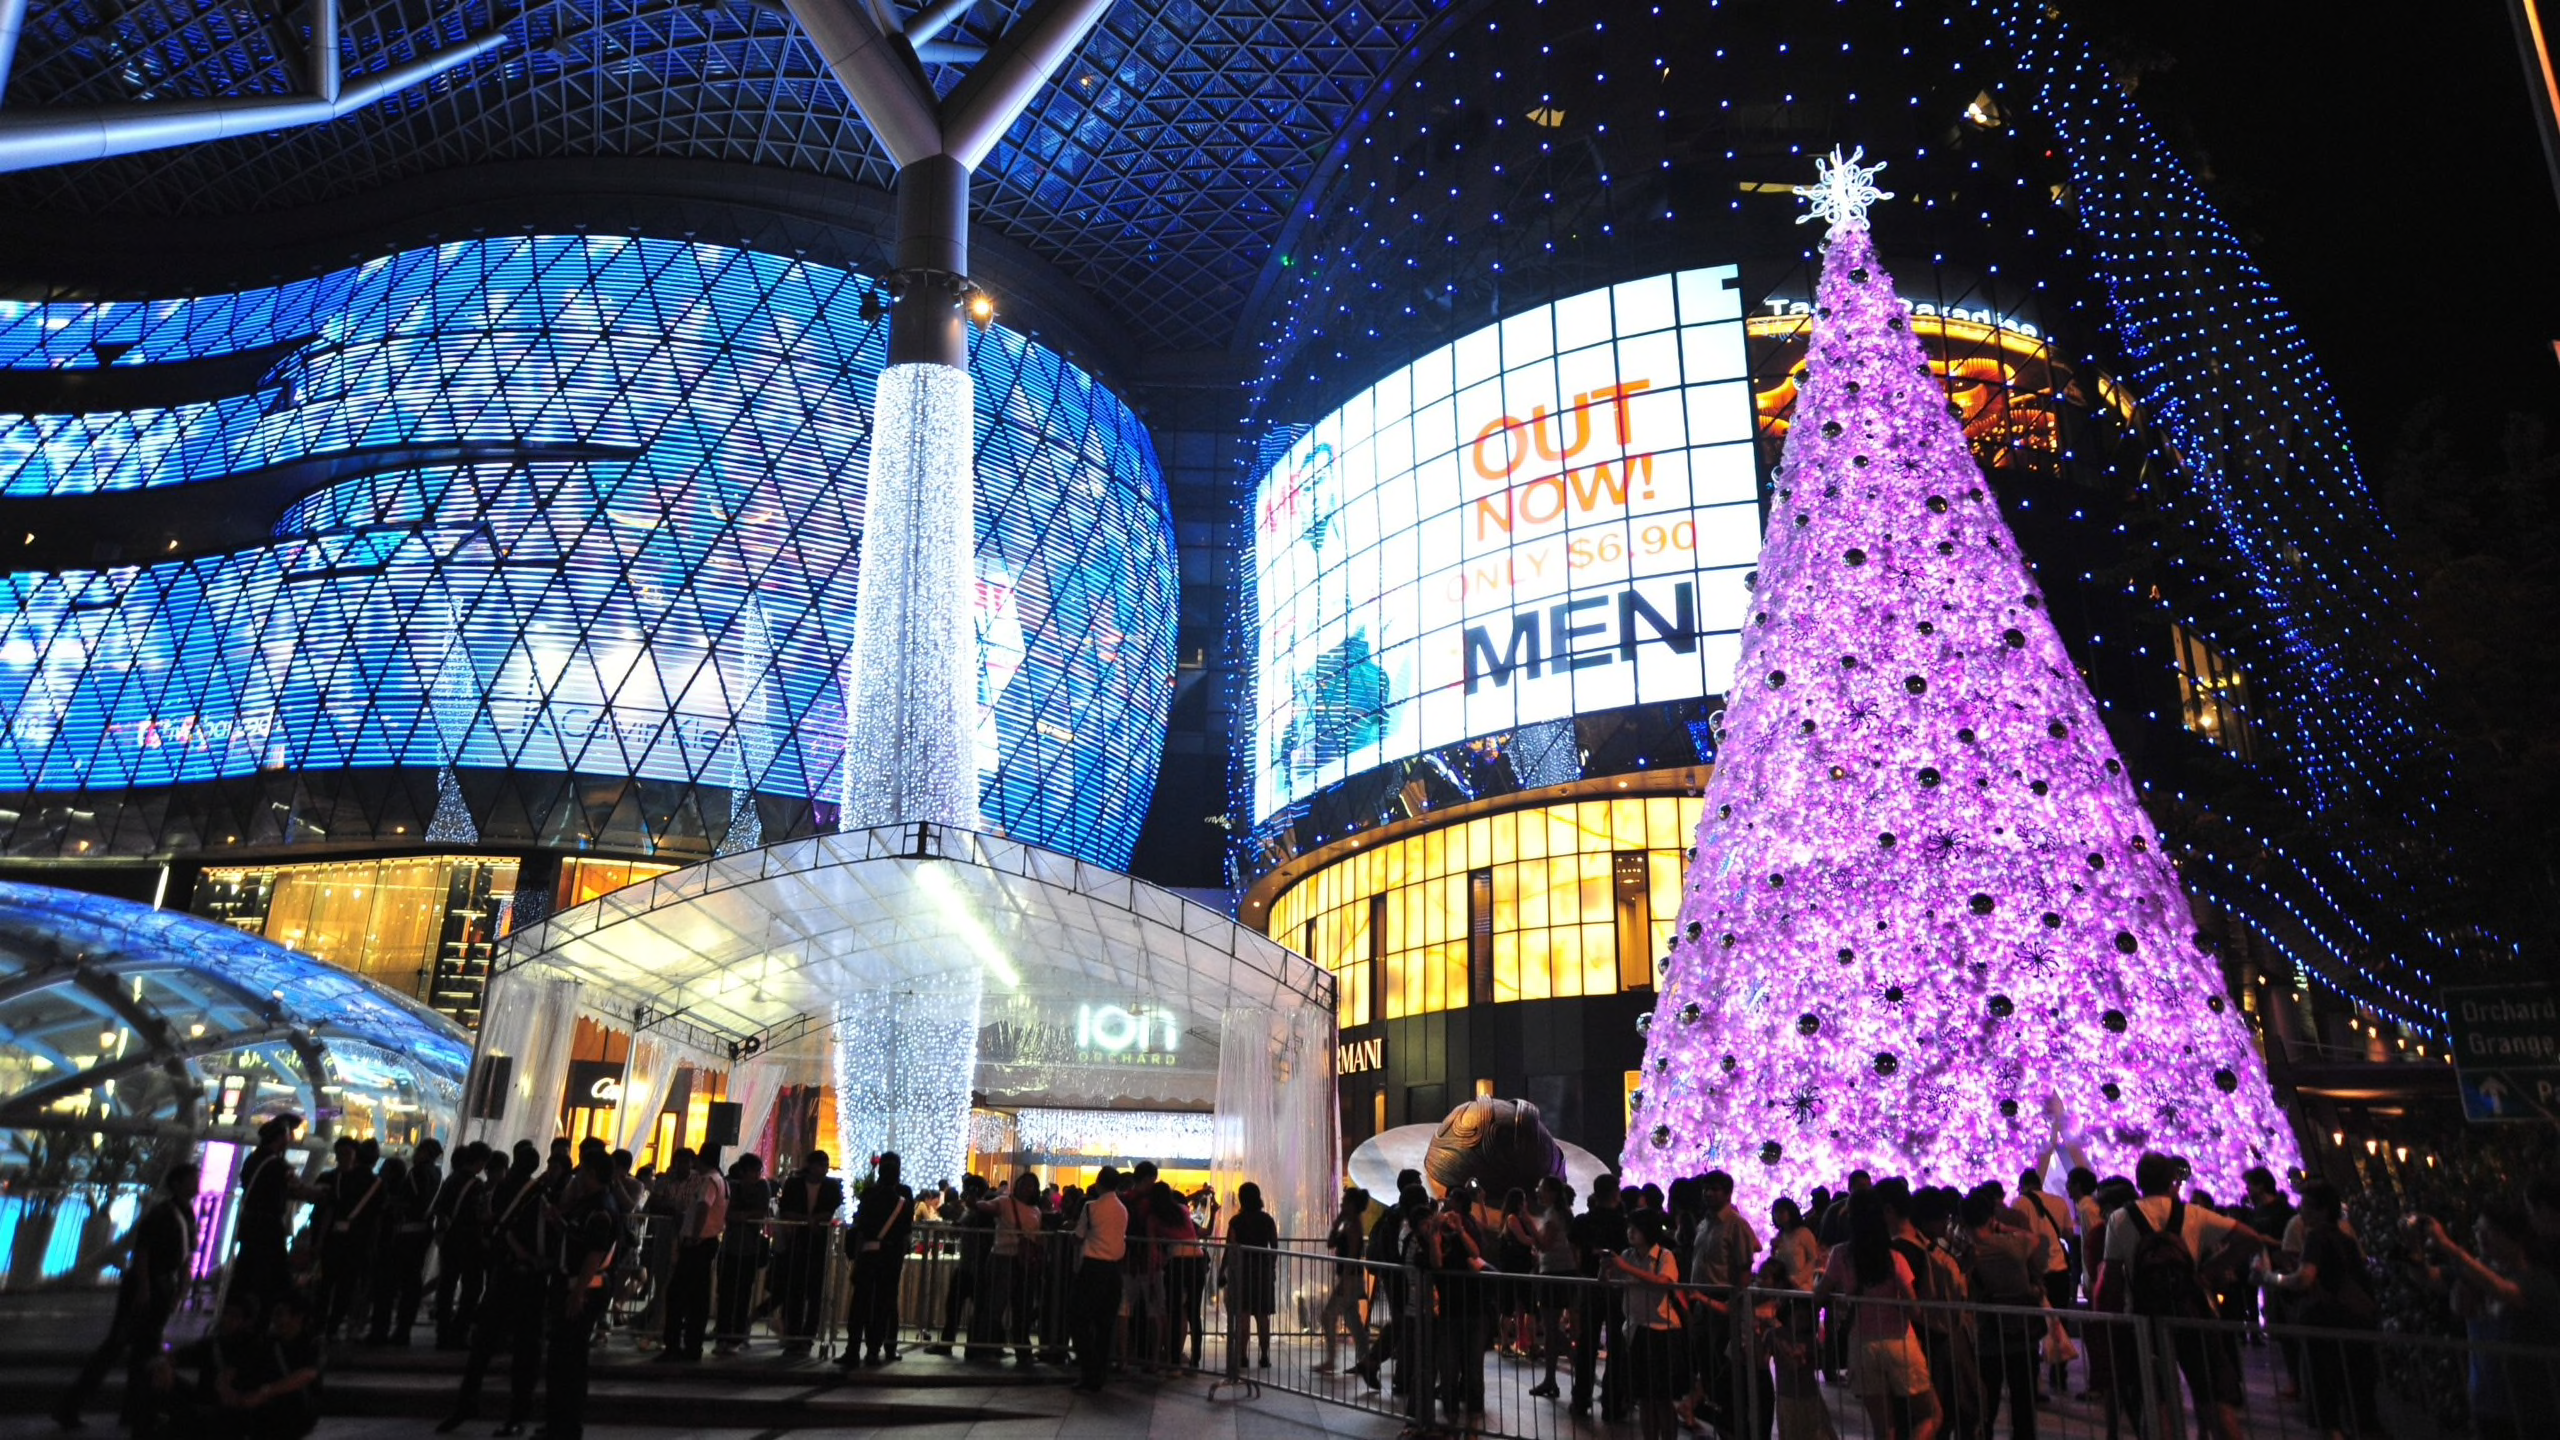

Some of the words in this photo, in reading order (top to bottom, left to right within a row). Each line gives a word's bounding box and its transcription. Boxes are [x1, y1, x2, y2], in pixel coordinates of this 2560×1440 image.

[1473, 378, 1650, 480] OUT
[1477, 453, 1655, 541] NOW!
[1447, 549, 1549, 603] ONLY
[1568, 521, 1697, 569] $6.90
[1463, 582, 1697, 696] MEN
[561, 708, 661, 745] Calvin
[2461, 997, 2556, 1023] Orchard
[1079, 1051, 1177, 1066] ORCHARD
[2468, 1032, 2554, 1058] Grange
